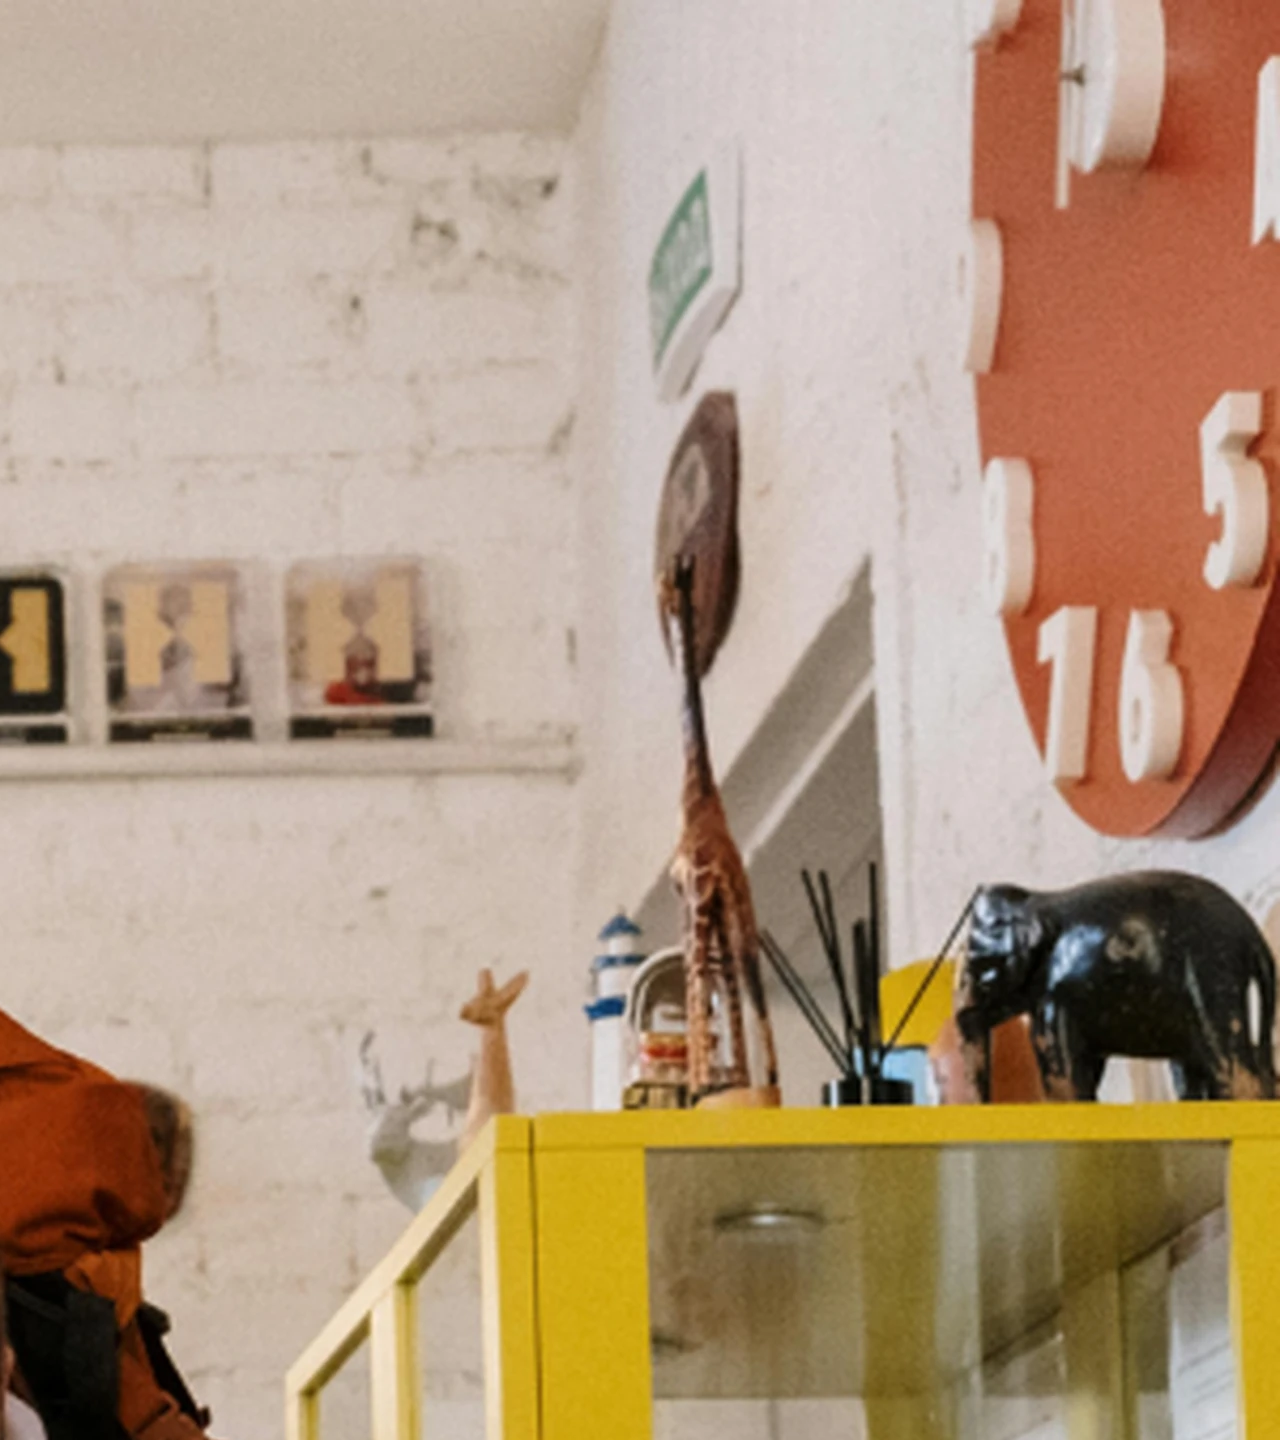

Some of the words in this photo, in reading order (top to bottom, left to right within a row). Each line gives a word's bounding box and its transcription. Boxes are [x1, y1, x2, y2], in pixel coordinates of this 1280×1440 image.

[1199, 390, 1270, 590] 5
[124, 579, 233, 687] H
[304, 576, 415, 682] H
